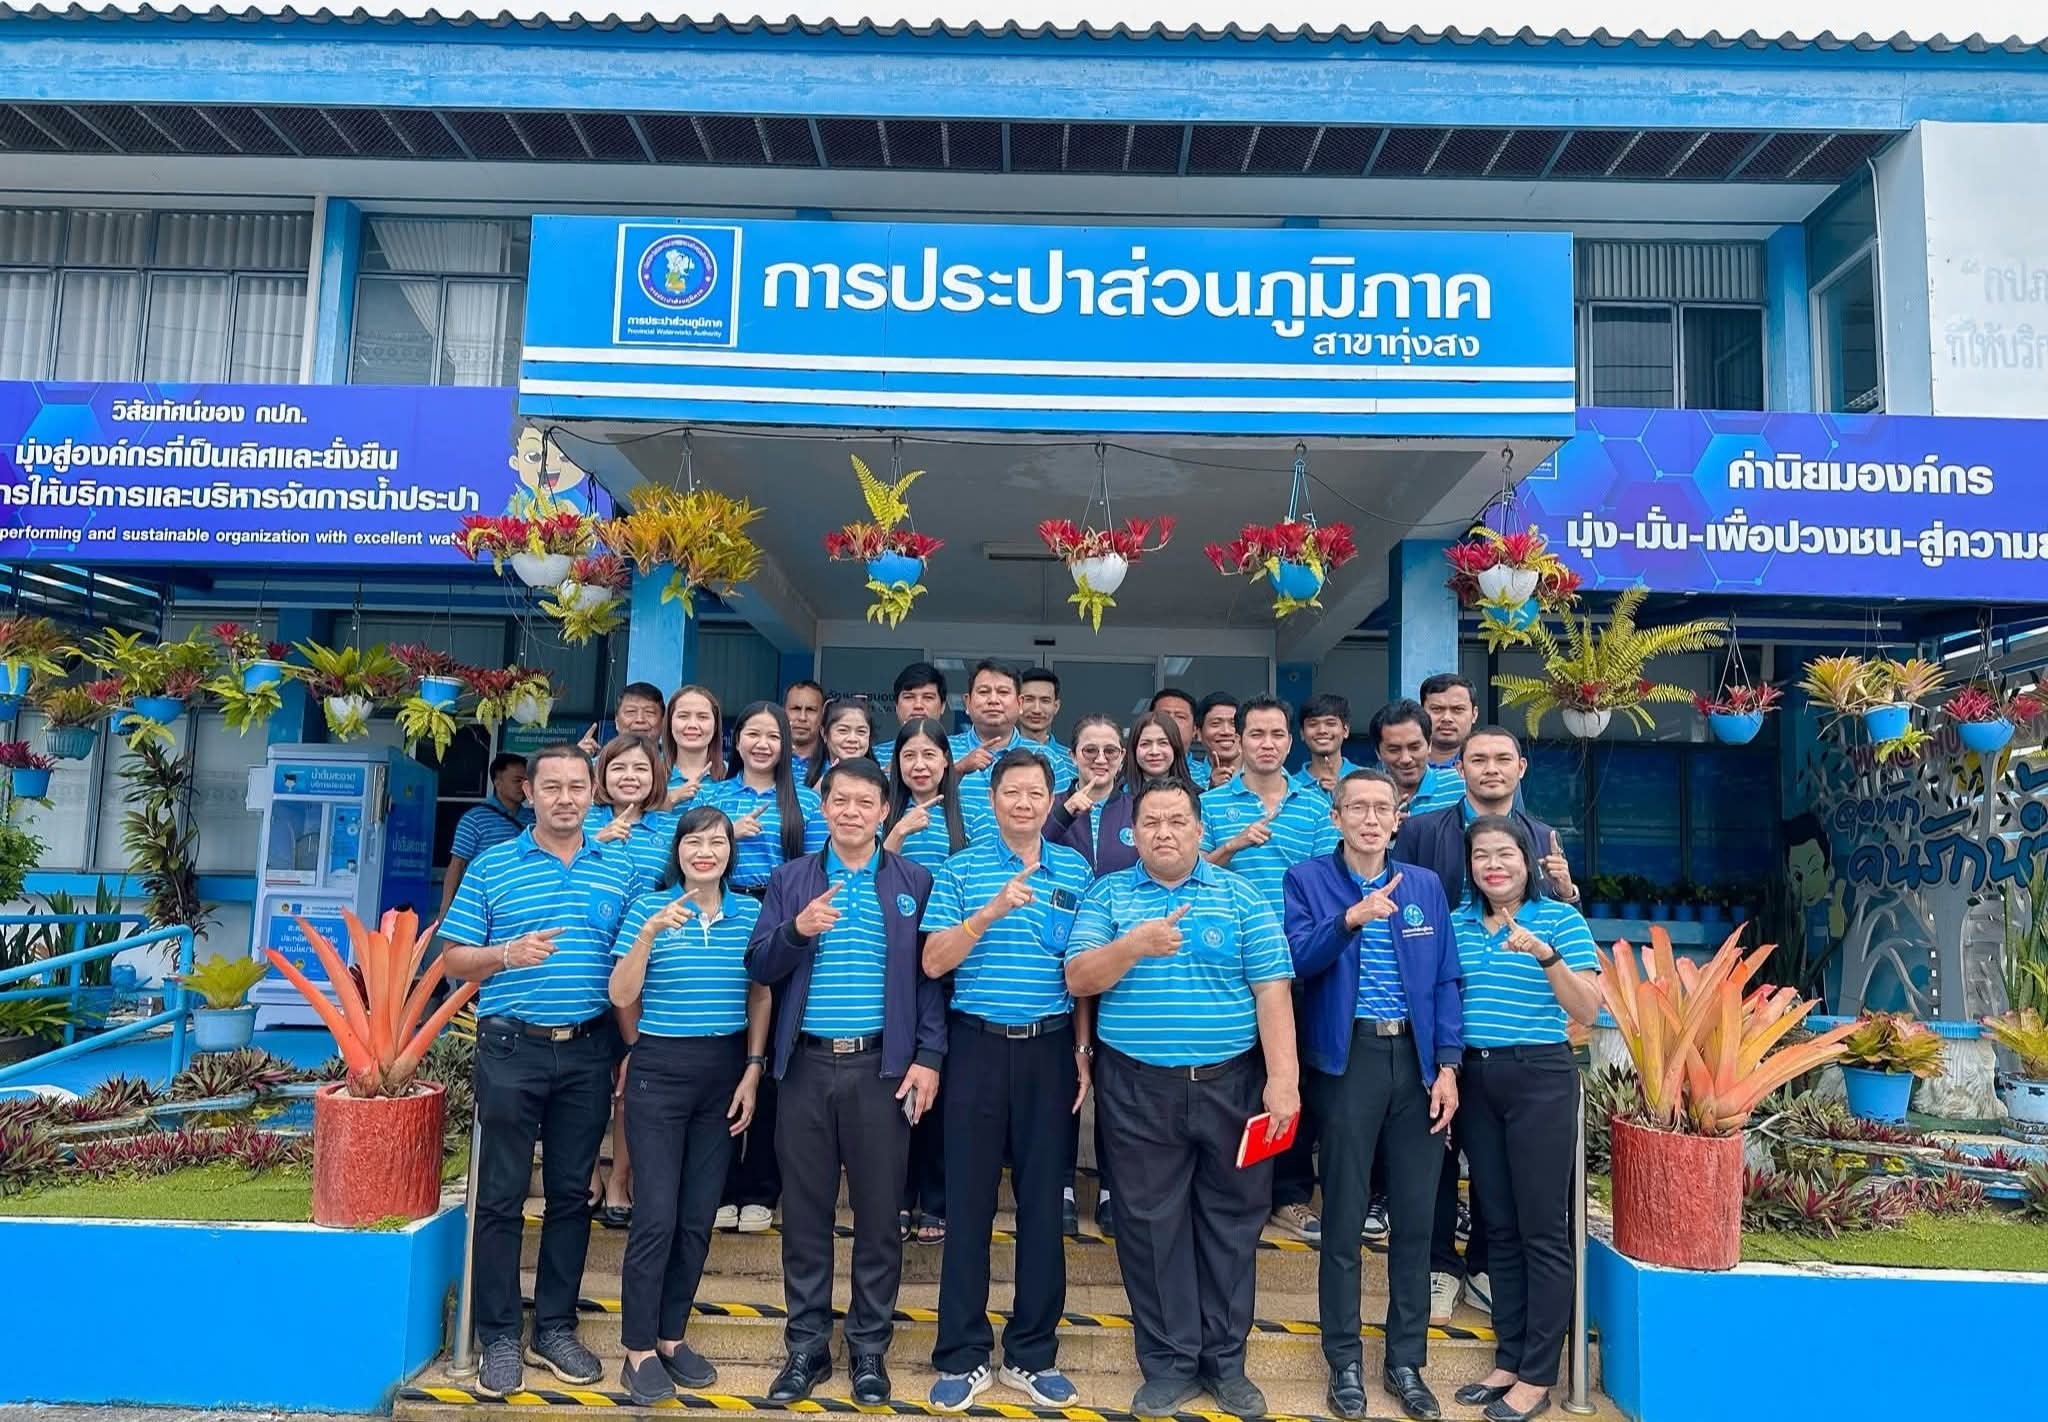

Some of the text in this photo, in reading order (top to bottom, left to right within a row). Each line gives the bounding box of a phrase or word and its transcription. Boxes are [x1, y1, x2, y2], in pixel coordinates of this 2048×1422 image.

[764, 246, 1491, 338] การประปาส่วนภูมิภาค
[627, 316, 723, 329] การประปาส่วนภูมิภาค
[627, 327, 722, 339] Provincial Waterworks Authority
[1313, 326, 1480, 364] สาขาทุ่งสง
[112, 399, 308, 423] วิสัยทัศน์ของ กปภ.
[15, 436, 398, 473] มุ่งสู่องค์กรที่เป็นเลิศและยั่งยืน
[1728, 451, 1994, 494] ค่านิยมองค์กร
[0, 525, 82, 543] performing
[87, 527, 116, 541] and
[122, 528, 210, 542] sustainable
[216, 529, 310, 545] organization
[315, 530, 347, 544] with
[354, 531, 423, 545] excellent
